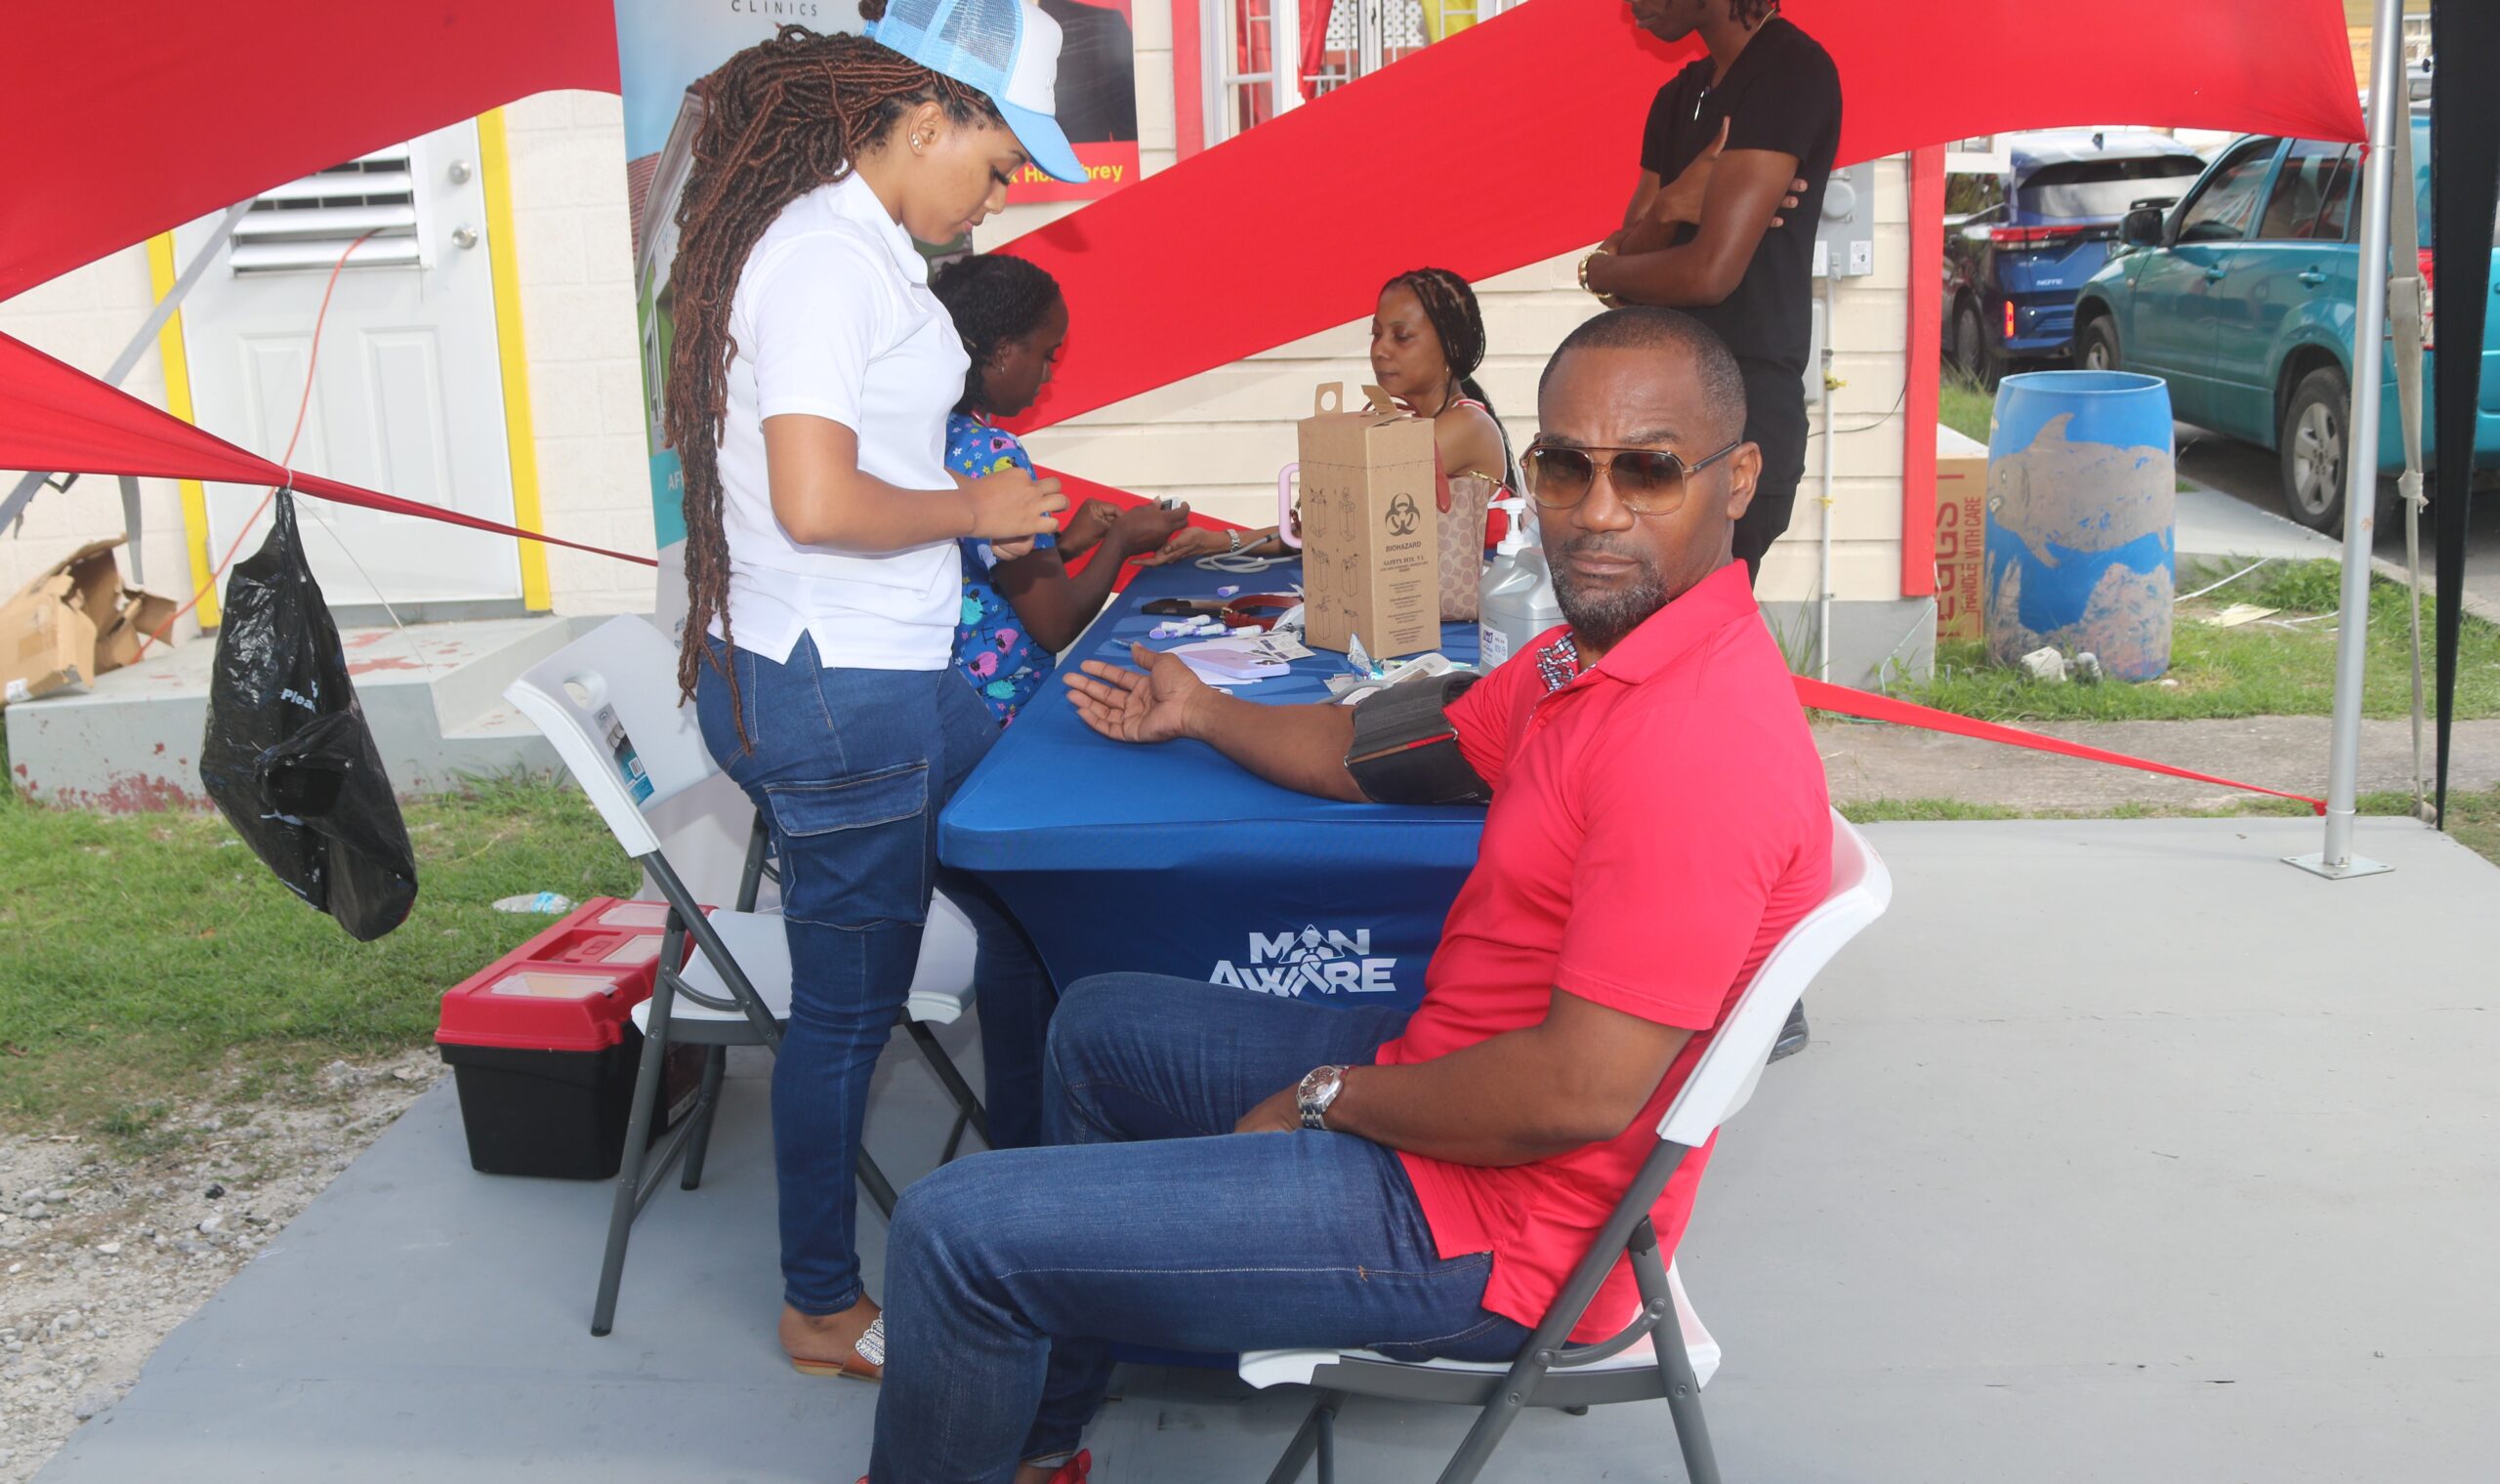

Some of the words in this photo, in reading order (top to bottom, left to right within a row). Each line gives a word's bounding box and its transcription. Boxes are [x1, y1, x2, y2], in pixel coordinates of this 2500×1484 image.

[730, 0, 817, 16] CLINICS
[1024, 164, 1122, 183] Huhrey
[1965, 496, 1980, 526] CARE
[1386, 541, 1421, 552] BIOHAZARD
[1965, 529, 1980, 559] WITH
[1936, 502, 1959, 620] EGGS
[1962, 564, 1978, 611] HANDLE
[1209, 958, 1397, 998] AWARE
